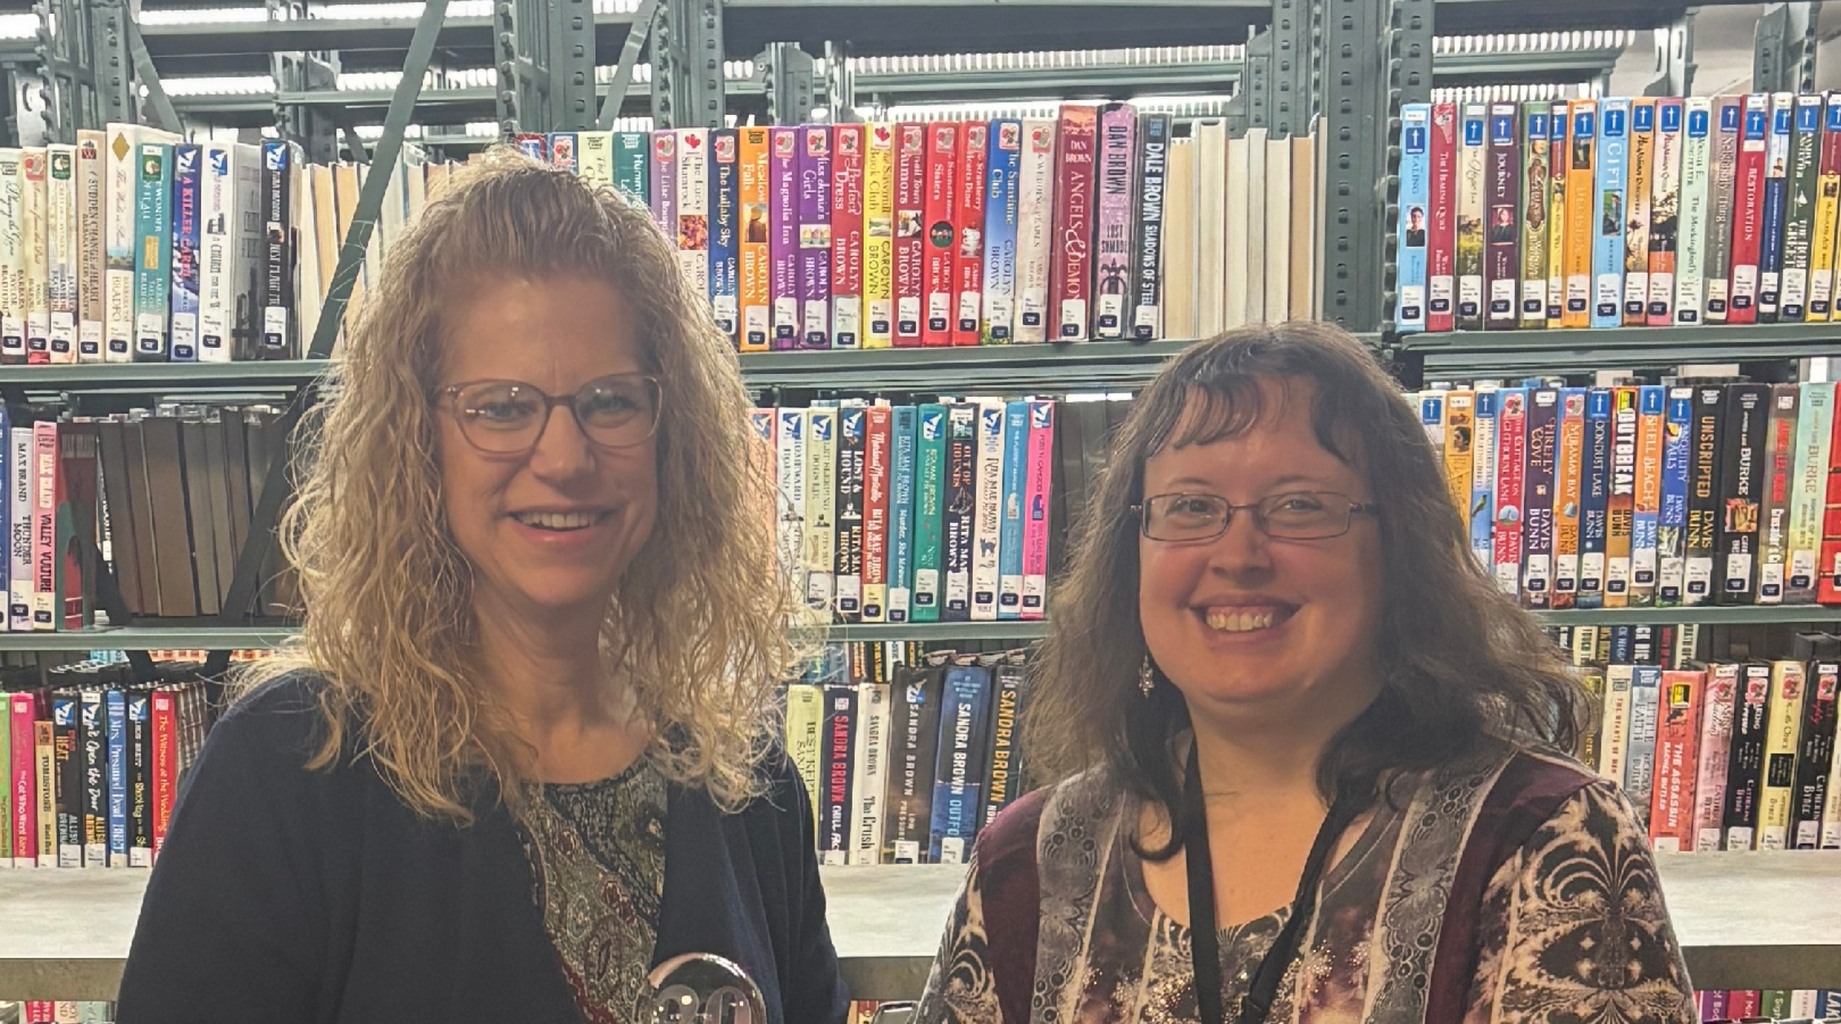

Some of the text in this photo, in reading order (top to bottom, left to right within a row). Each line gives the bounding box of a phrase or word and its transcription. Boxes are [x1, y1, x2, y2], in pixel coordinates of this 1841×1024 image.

[1066, 152, 1092, 163] BROWN
[1071, 140, 1087, 150] DAN
[1105, 126, 1128, 196] DAN BROWN
[743, 163, 755, 191] Falls
[757, 152, 769, 203] Meadow
[802, 168, 816, 200] Girls
[835, 170, 848, 210] Dress
[869, 147, 881, 211] Book Club
[881, 165, 892, 214] Sawmill
[933, 163, 945, 201] Sisters
[990, 168, 1004, 200] Club
[1005, 171, 1019, 226] Sunshine
[1497, 152, 1508, 199] JOURNEY
[182, 188, 193, 234] KILLER
[716, 166, 731, 247] The Lullaby Sky
[779, 171, 793, 245] Magnolia Inn
[1069, 171, 1085, 229] ANGELS
[1142, 142, 1164, 282] DALE BROWN SHADOWS OF
[1744, 168, 1758, 241] RESTORATION
[745, 250, 757, 298] BROWN
[759, 246, 769, 303] CAROLYN
[805, 256, 816, 297] BROWN
[818, 250, 828, 302] CAROLYN
[836, 237, 847, 286] BROWN
[849, 230, 859, 292] CAROLYN
[868, 245, 879, 295] BROWN
[881, 240, 891, 300] CAROLYN
[898, 246, 910, 295] BROWN
[911, 240, 922, 297] CAROLYN
[990, 246, 1002, 291] BROWN
[1002, 240, 1014, 297] CAROLYN
[962, 445, 972, 486] OUT OF
[1512, 435, 1524, 480] COTTAGE
[1530, 427, 1544, 468] COVE
[1542, 424, 1556, 476] FIREFLY
[1565, 423, 1580, 499] MIRAMAR BAY
[1613, 409, 1636, 496] OUTBREAK
[1644, 416, 1657, 500] SHELL BEACH
[1696, 415, 1716, 499] UNSCRIPTED
[1804, 445, 1819, 493] BURKE
[18, 443, 28, 502] MAX BRAND
[840, 449, 853, 494] HOUND
[852, 451, 865, 493] LOST &
[1592, 473, 1603, 498] LAKE
[1738, 447, 1752, 495] BURKE
[960, 515, 971, 545] RITA
[1529, 508, 1540, 550] BUNN
[1540, 508, 1552, 550] DAVIS
[1585, 510, 1595, 539] BUNN
[1595, 510, 1604, 539] DAVIS
[1611, 509, 1621, 537] BUNN
[1621, 509, 1631, 536] DAVIS
[1665, 494, 1675, 524] BUNN
[1674, 494, 1684, 524] DAVIS
[1689, 510, 1702, 549] BUNN
[1701, 510, 1714, 548] DAVIS
[13, 523, 22, 558] MOON
[22, 514, 32, 566] THUNDER
[40, 513, 52, 592] VALLEY VULTURE
[839, 530, 850, 572] BROWN
[850, 525, 862, 551] RITA
[949, 522, 960, 568] BROWN
[1496, 531, 1508, 563] BUNN
[1560, 525, 1569, 555] BUNN
[1569, 525, 1578, 555] DAVIS
[159, 715, 169, 731] The
[806, 721, 818, 756] BEST
[1633, 703, 1647, 741] FAITH
[1643, 701, 1657, 743] LITTLE
[56, 736, 70, 761] HEAT
[866, 715, 880, 776] SANDRA BROWN
[903, 704, 920, 797] SANDRA BROWN
[949, 702, 972, 795] SANDRA BROWN
[989, 690, 1017, 803] SANDRA BROWN
[42, 755, 51, 812] TOMBSTONE
[830, 715, 849, 831] SANDRA BROWN CHILL
[1631, 758, 1643, 791] BUTLER
[1658, 741, 1671, 811] RACHEL BUTLER
[1668, 742, 1684, 828] THE ASSASSIN
[111, 793, 124, 818] Dead
[860, 795, 877, 850] The Crush
[907, 812, 917, 830] LOW
